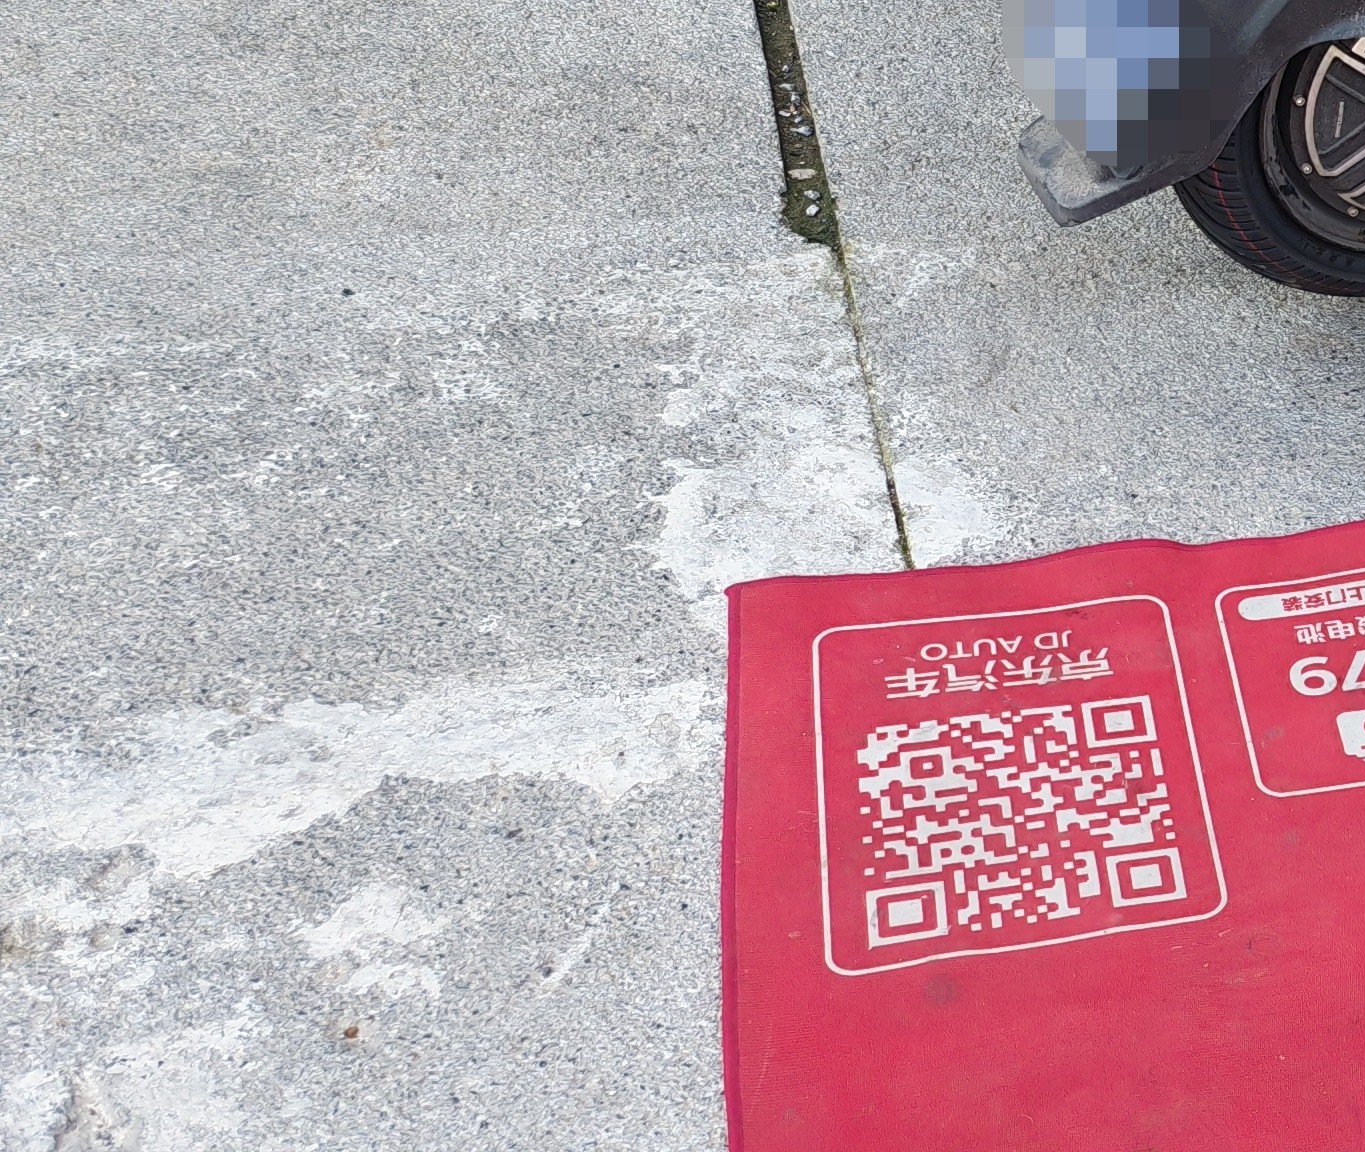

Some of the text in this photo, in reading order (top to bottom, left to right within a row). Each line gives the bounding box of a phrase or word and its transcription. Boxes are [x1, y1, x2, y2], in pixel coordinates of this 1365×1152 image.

[920, 630, 1072, 661] JD AUTO
[884, 647, 1114, 698] 京东汽车
